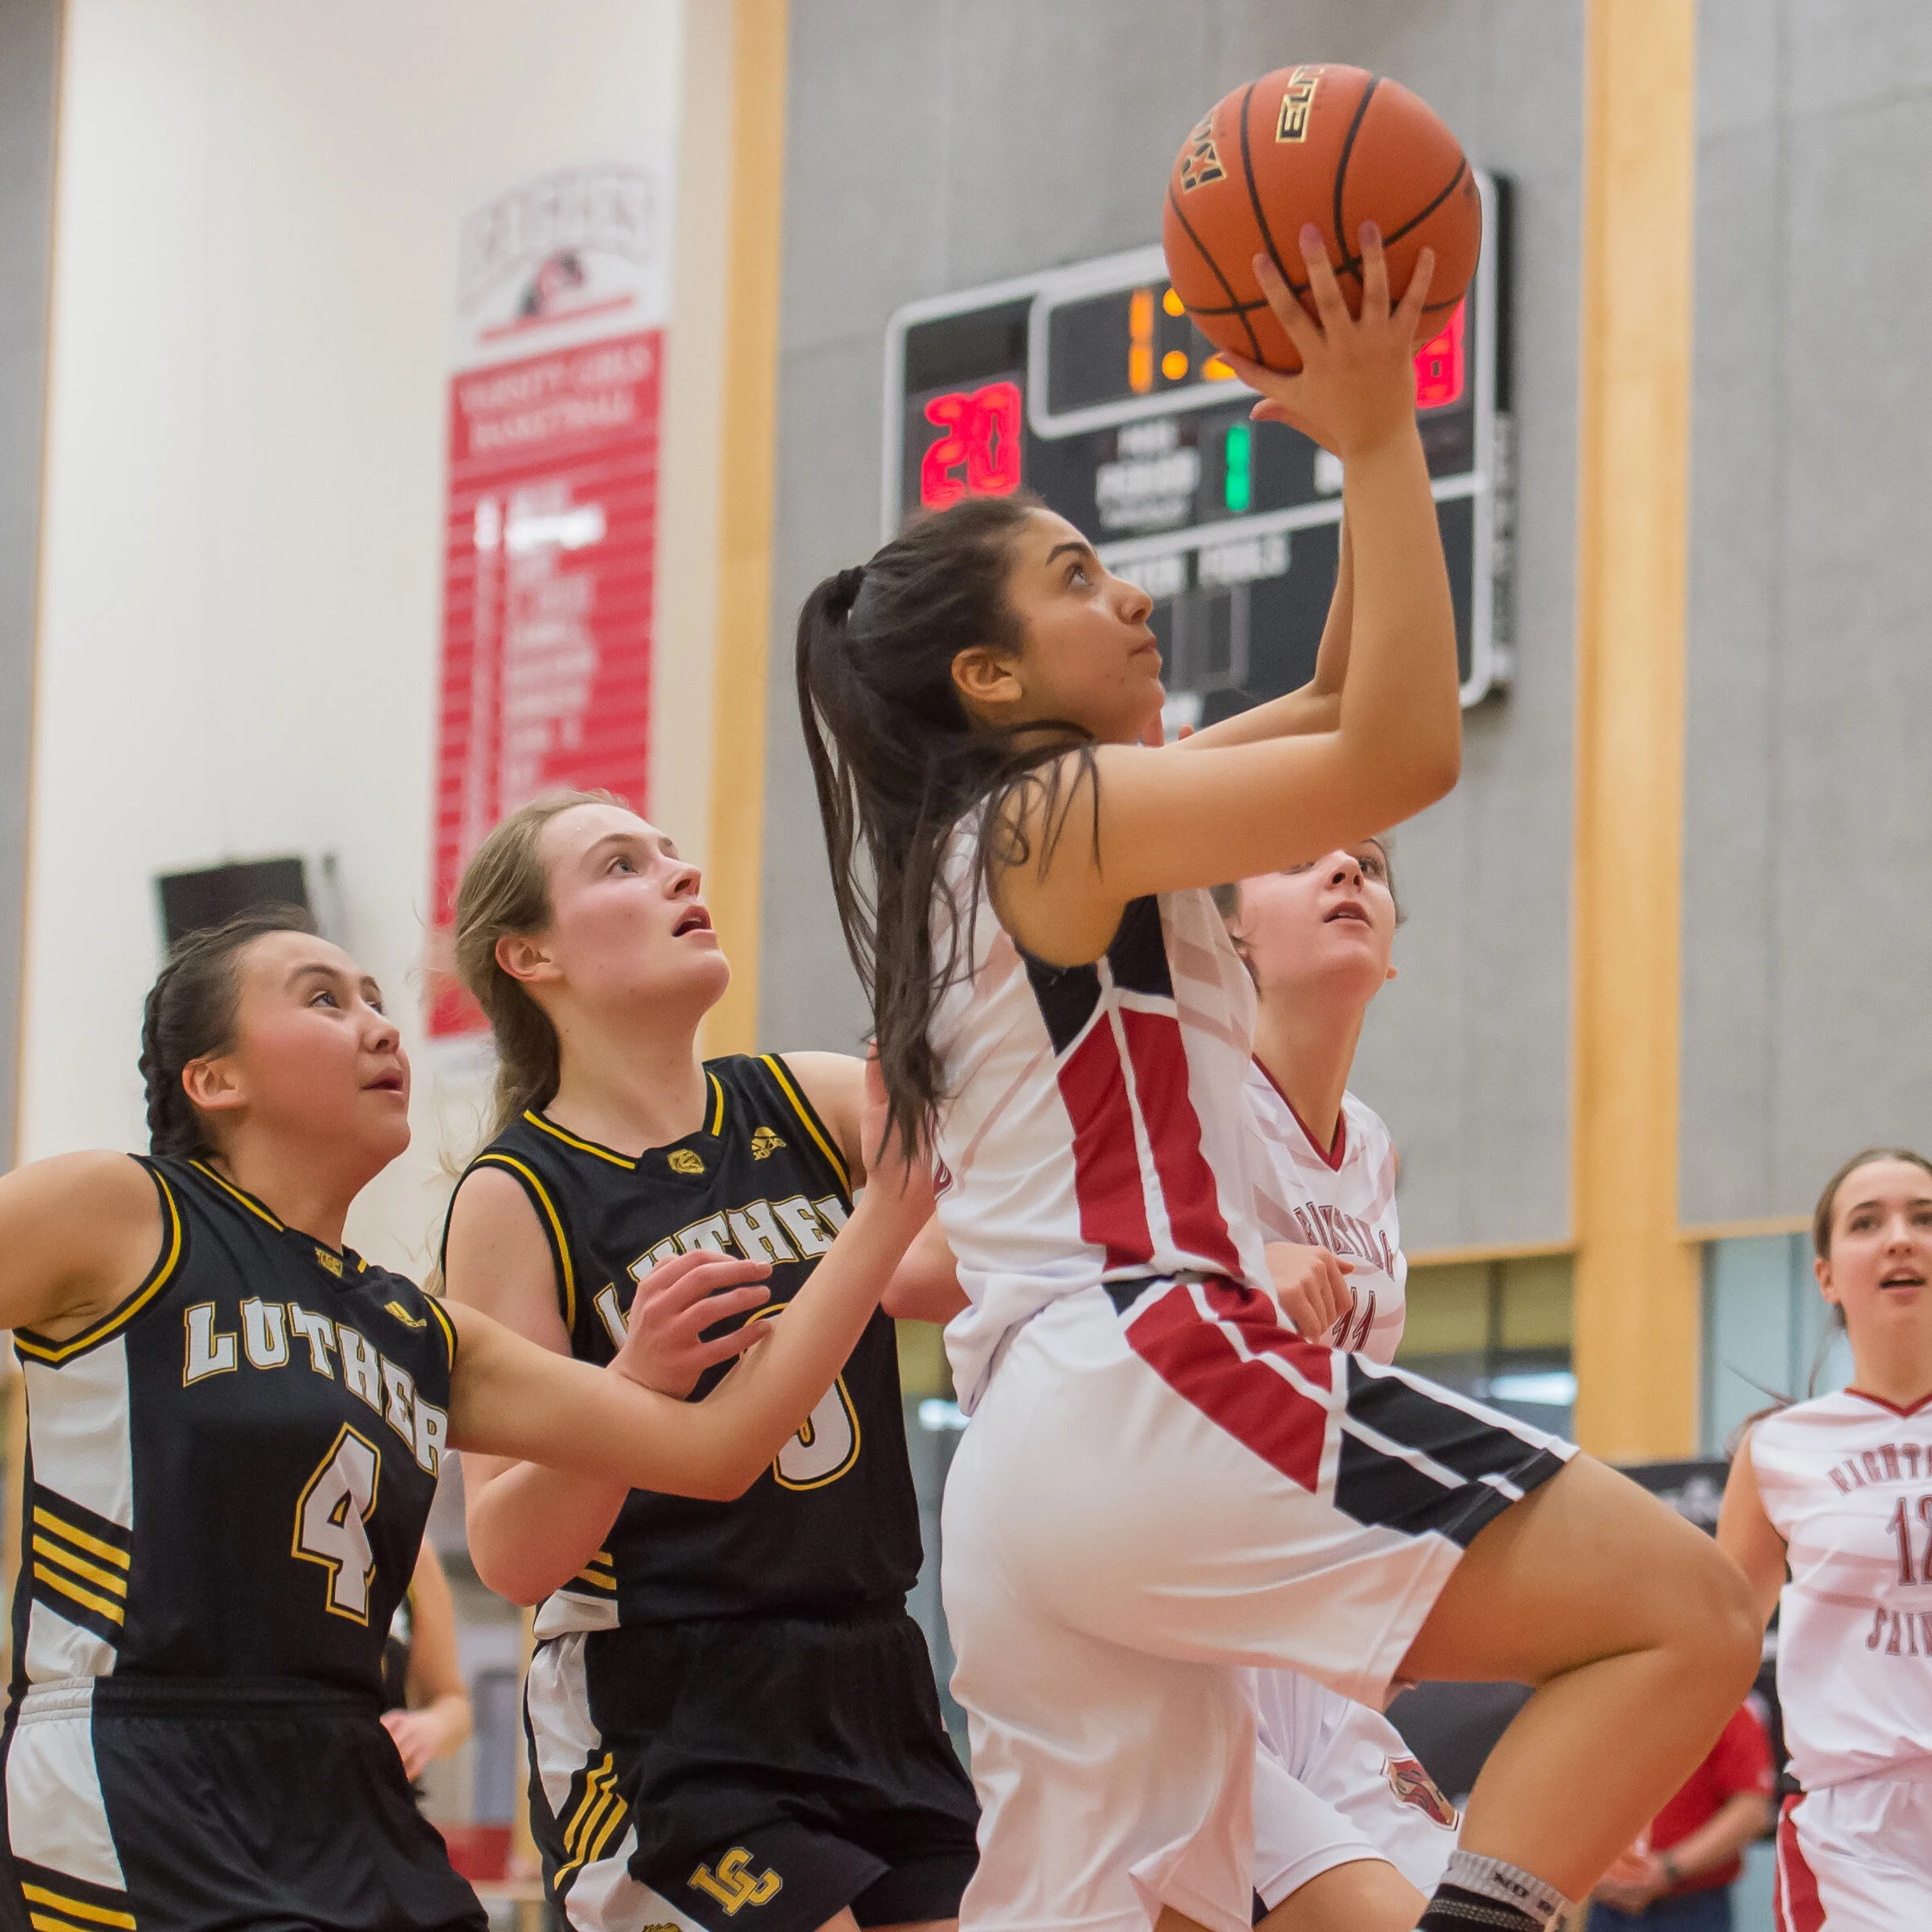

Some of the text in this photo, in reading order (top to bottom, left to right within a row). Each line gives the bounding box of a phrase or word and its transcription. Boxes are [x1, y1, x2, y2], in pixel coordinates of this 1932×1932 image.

[1128, 289, 1237, 395] 1:
[921, 382, 1022, 512] 20
[1224, 424, 1250, 512] 1
[1332, 1286, 1376, 1353] 11
[183, 1296, 448, 1479] LUTHER
[291, 1422, 382, 1628] 4
